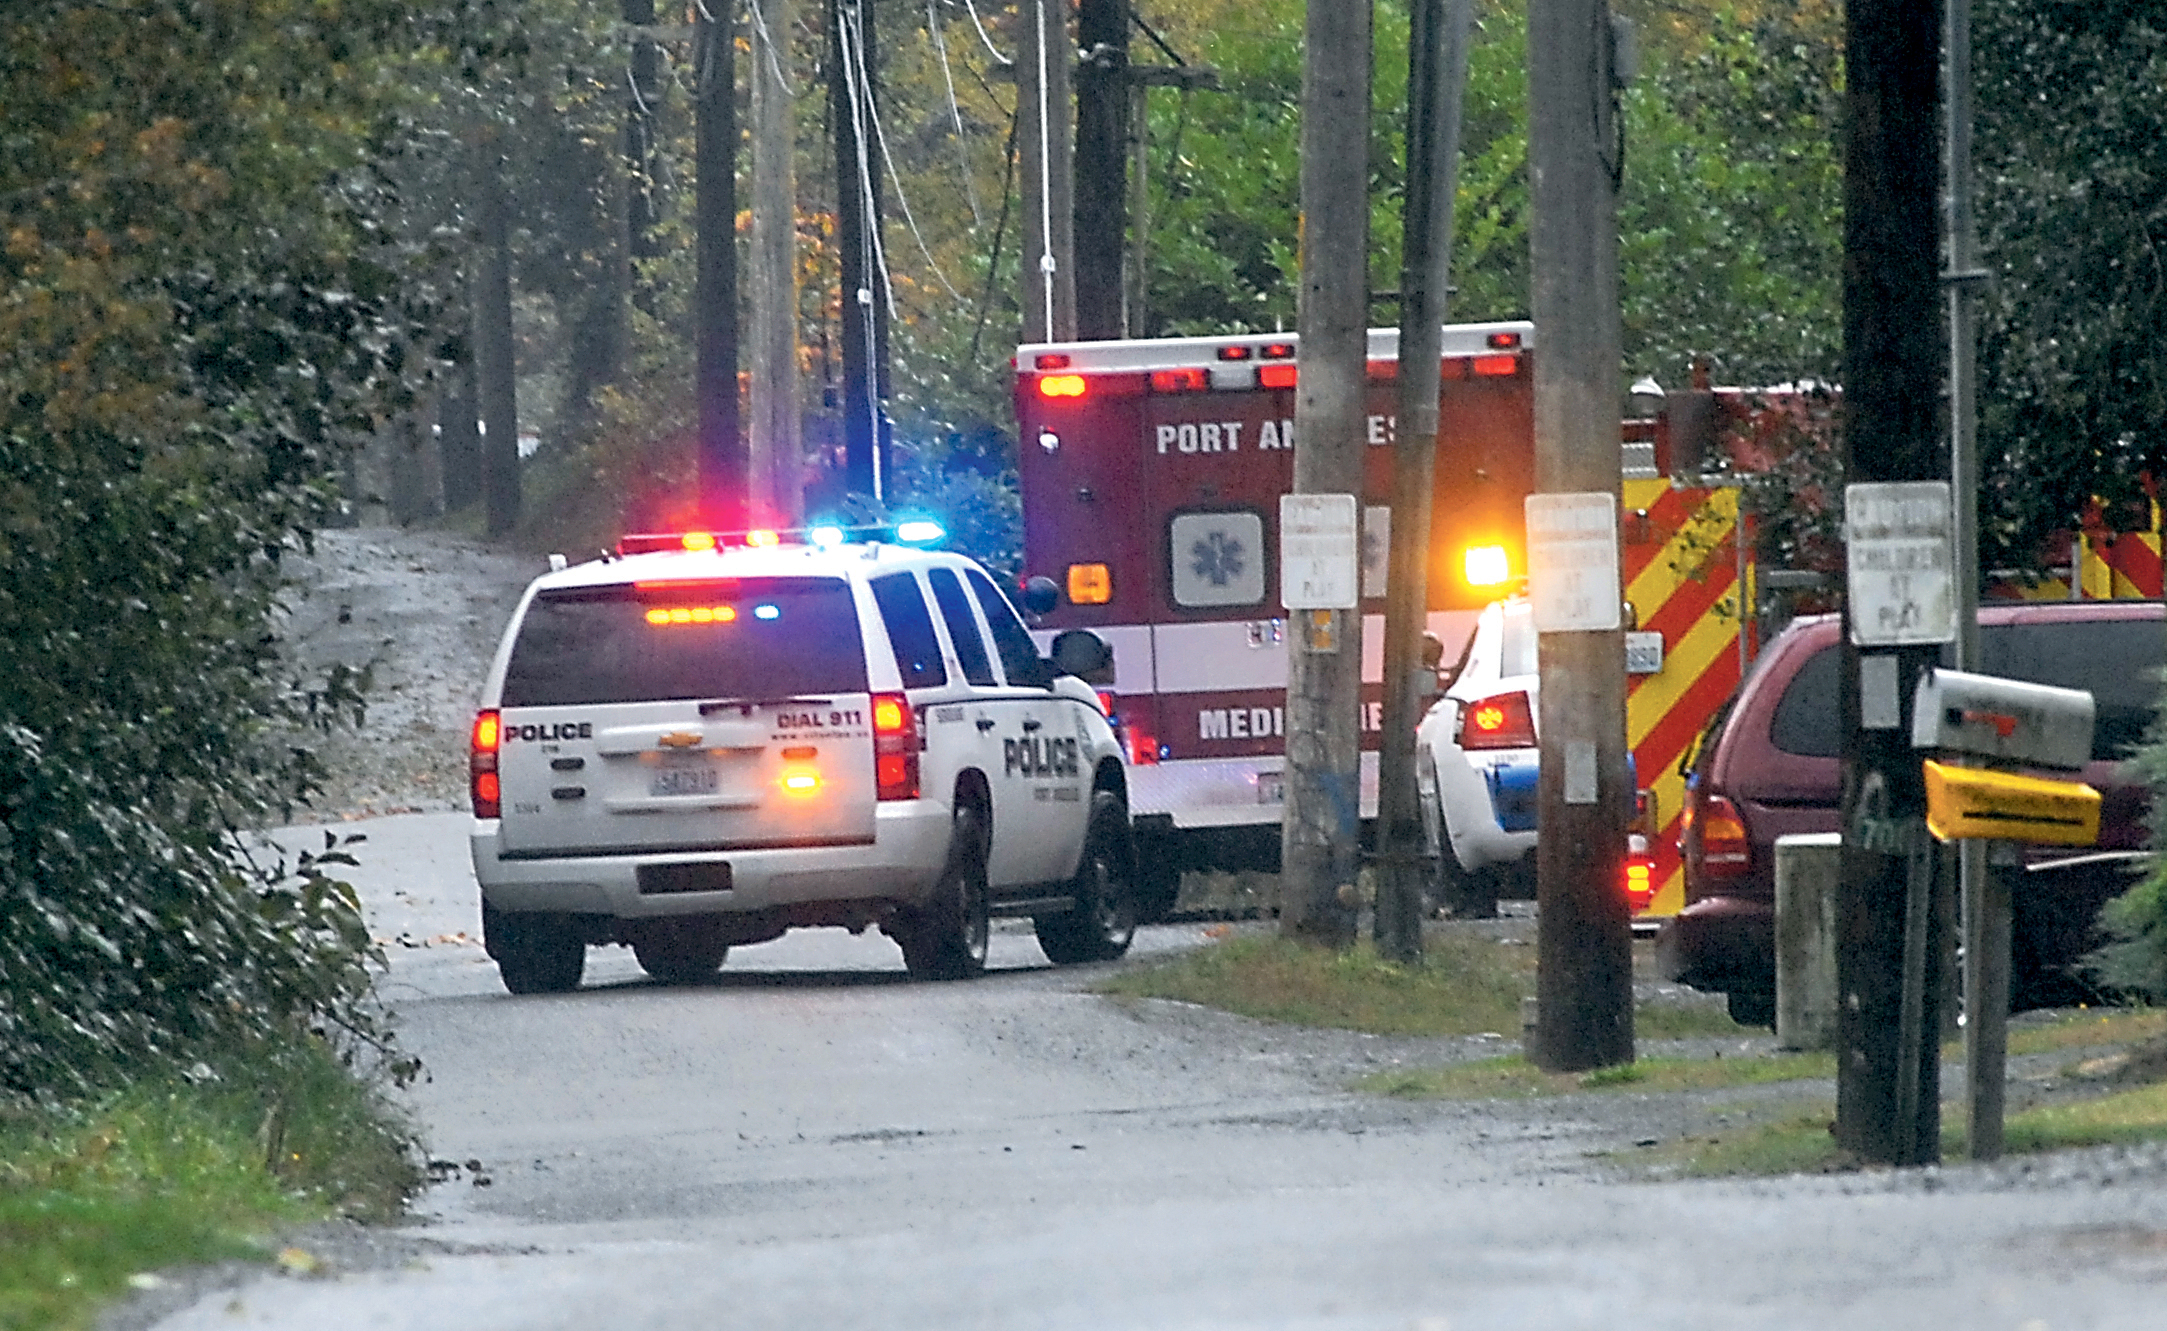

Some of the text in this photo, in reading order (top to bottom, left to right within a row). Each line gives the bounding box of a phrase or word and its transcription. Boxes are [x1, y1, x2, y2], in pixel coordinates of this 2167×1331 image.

[1156, 422, 1242, 453] PORT
[777, 710, 861, 728] DIAL 911
[505, 722, 592, 742] POLICE
[1003, 736, 1078, 778] POLICE
